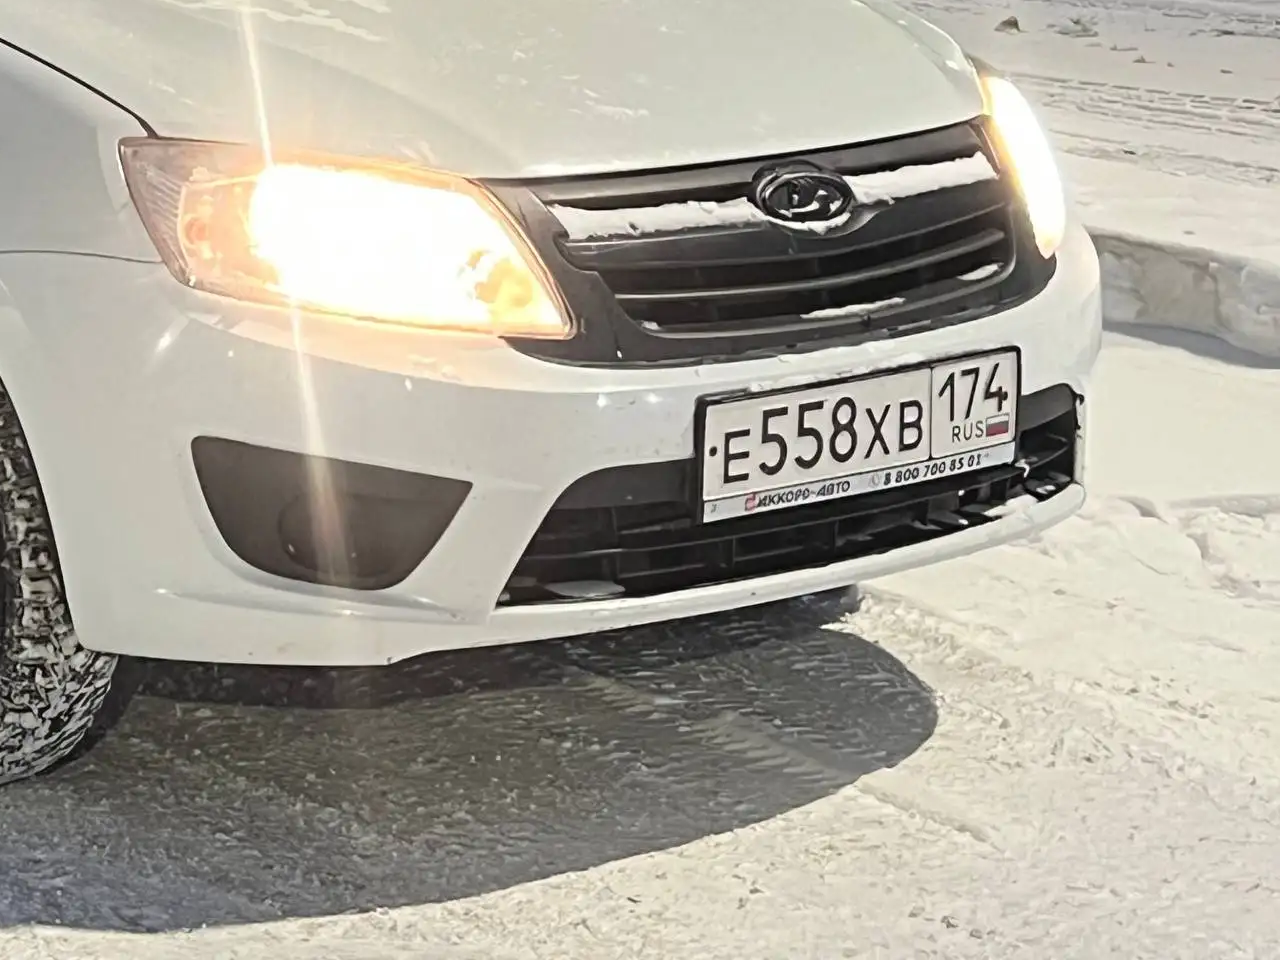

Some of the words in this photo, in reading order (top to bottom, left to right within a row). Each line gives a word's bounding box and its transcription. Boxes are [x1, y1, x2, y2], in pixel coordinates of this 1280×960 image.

[723, 397, 924, 484] Е558ХВ
[938, 362, 1009, 422] 174
[951, 420, 985, 443] RUS
[895, 467, 920, 483] 800
[922, 461, 946, 478] 700
[949, 456, 965, 472] 85
